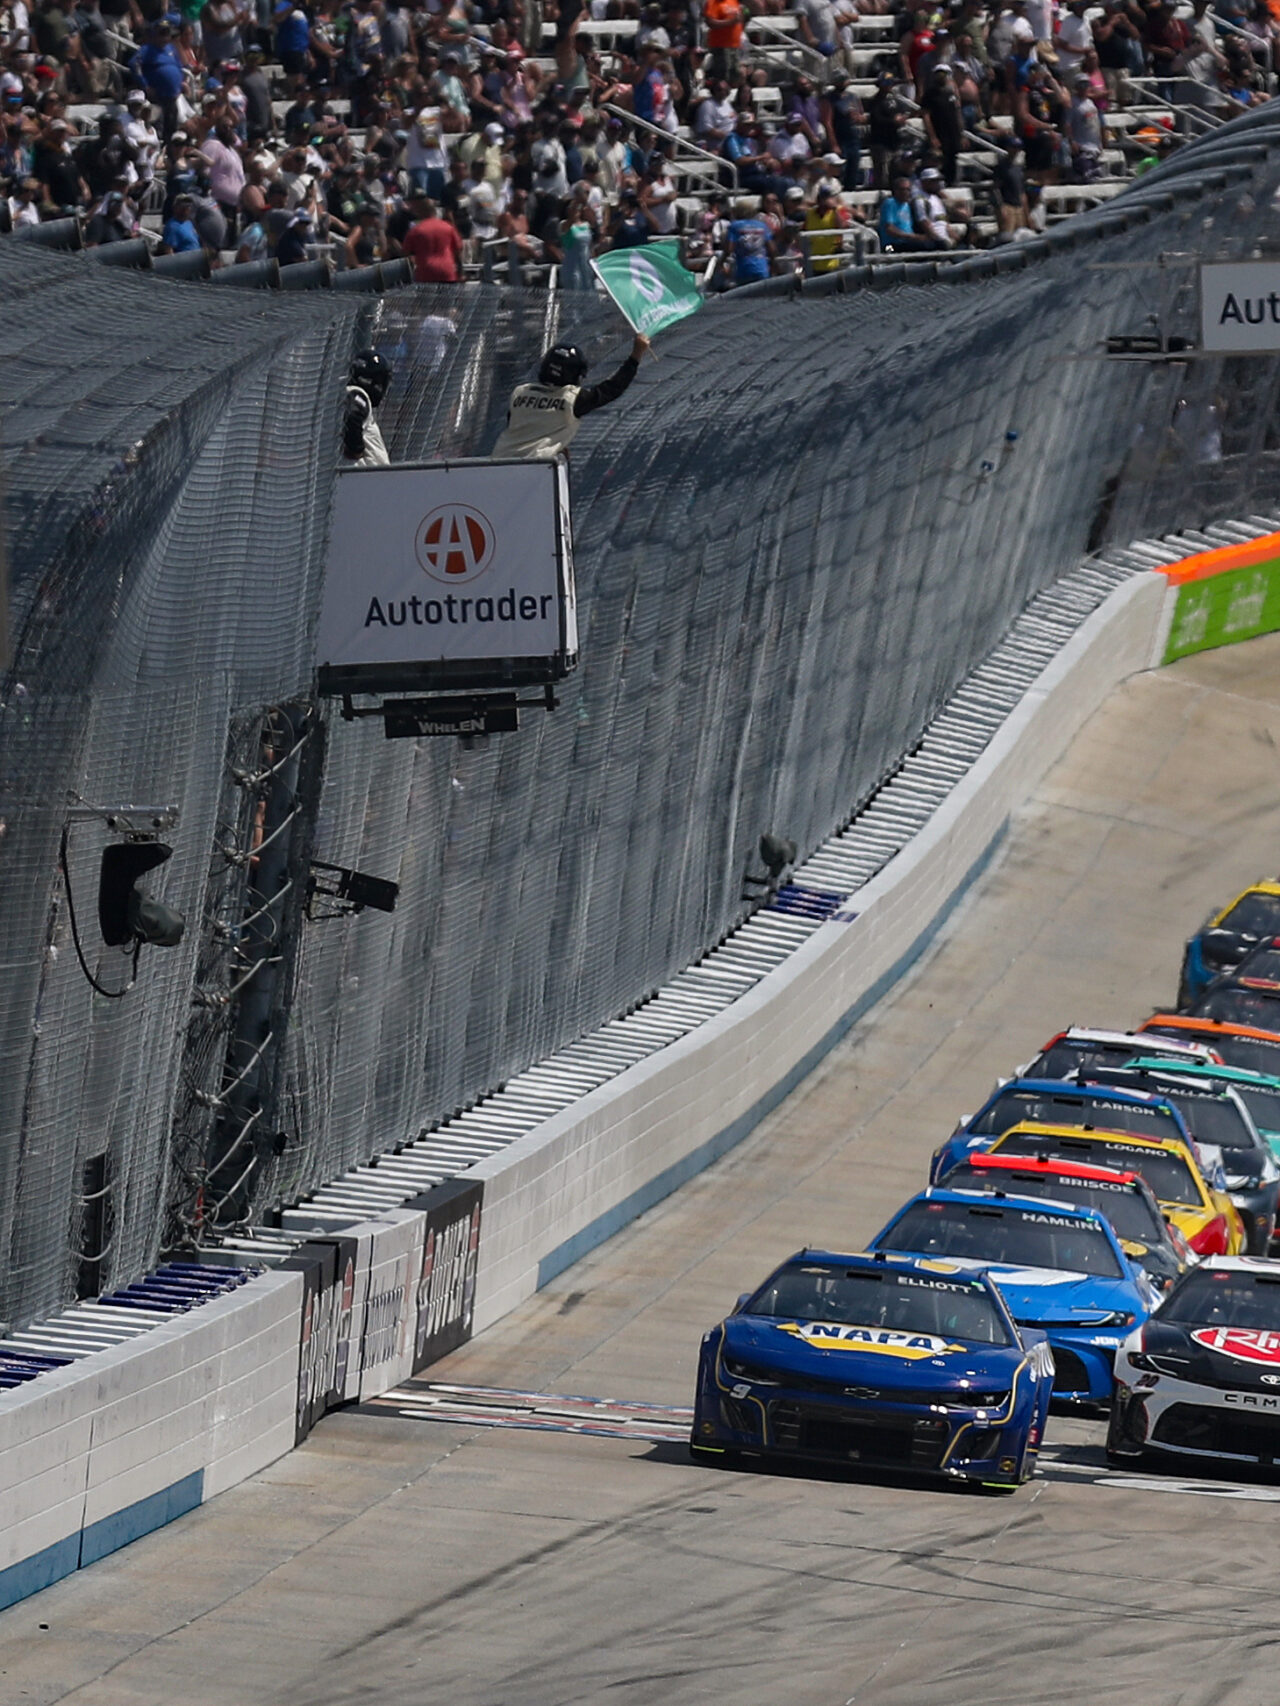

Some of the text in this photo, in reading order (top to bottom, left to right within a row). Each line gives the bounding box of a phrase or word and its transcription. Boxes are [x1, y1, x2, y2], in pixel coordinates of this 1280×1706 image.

[512, 395, 567, 411] OFFICIAL
[364, 587, 553, 628] Autotrader
[418, 718, 486, 735] WHELEN
[1092, 1100, 1155, 1116] LARSON
[1105, 1142, 1168, 1157] LOGANO
[1059, 1177, 1134, 1193] BRISCOE
[1022, 1212, 1095, 1231] HAMLIN
[898, 1275, 972, 1294] ELLIOTT
[811, 1324, 935, 1350] NAPA
[729, 1383, 751, 1399] 9
